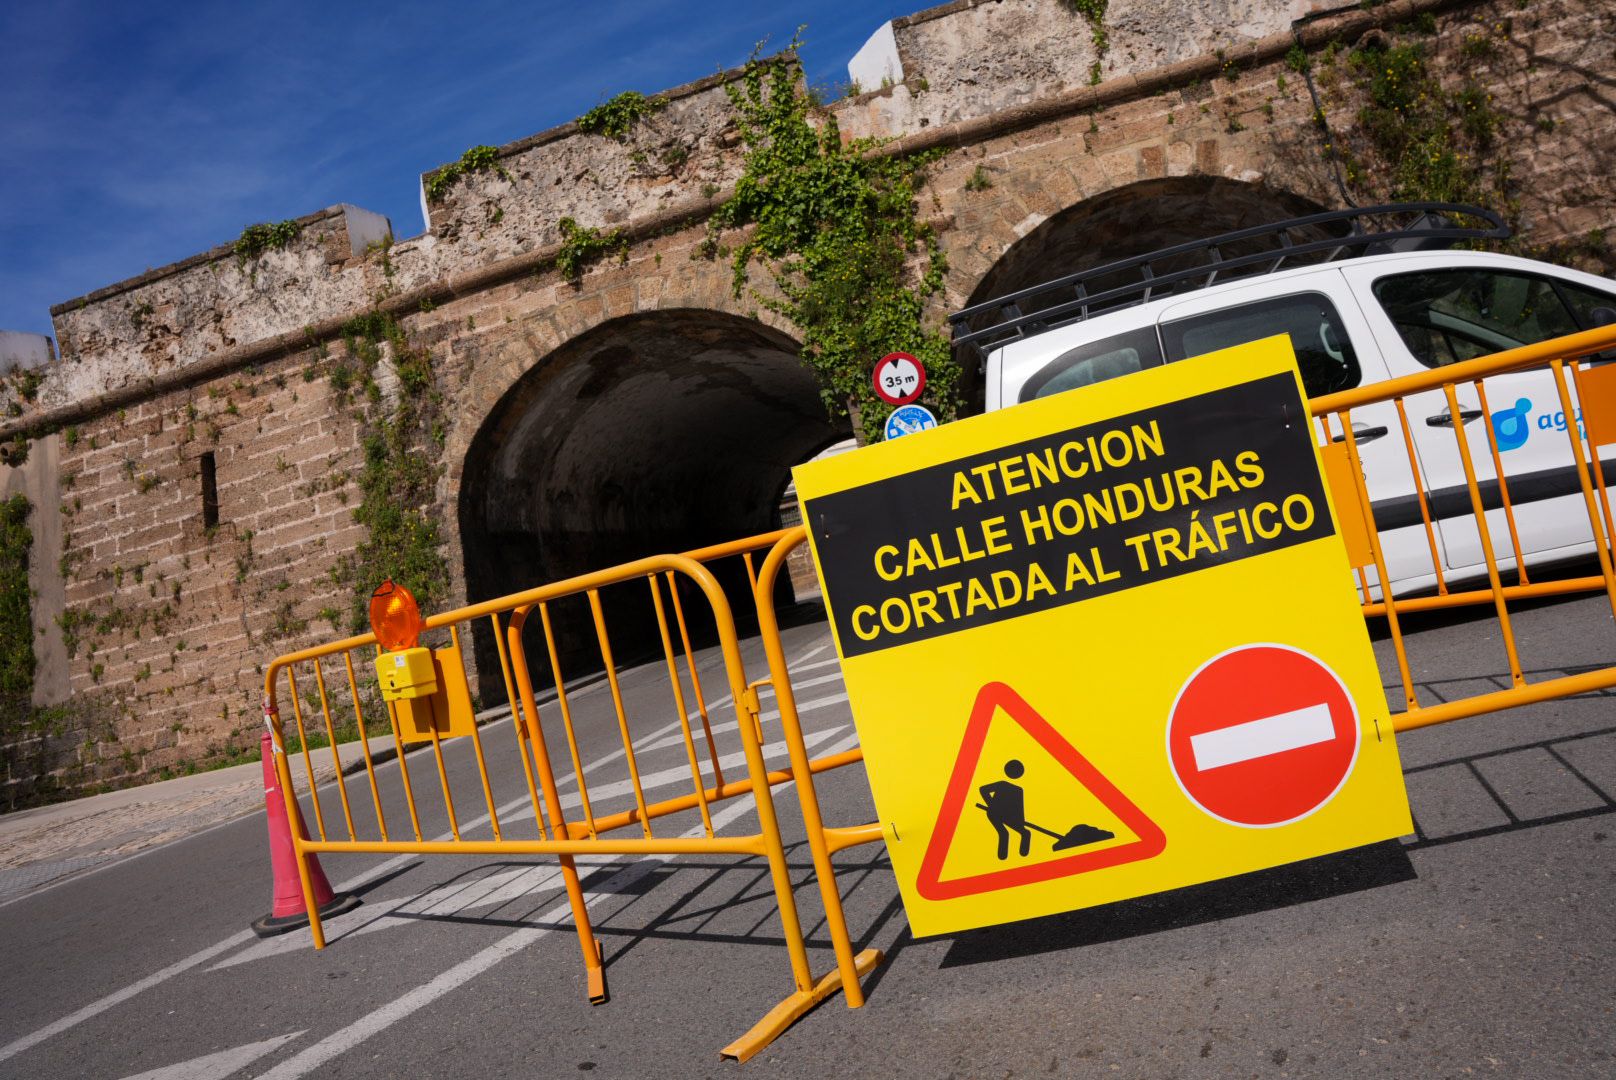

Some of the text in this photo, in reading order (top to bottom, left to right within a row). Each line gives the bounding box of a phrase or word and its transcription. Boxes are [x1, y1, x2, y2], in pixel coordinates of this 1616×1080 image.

[904, 375, 915, 384] m
[874, 450, 1265, 582] CALLE HONDURAS
[951, 419, 1165, 511] ATENCION
[851, 493, 1315, 641] CORTADA AL TRÁFICO
